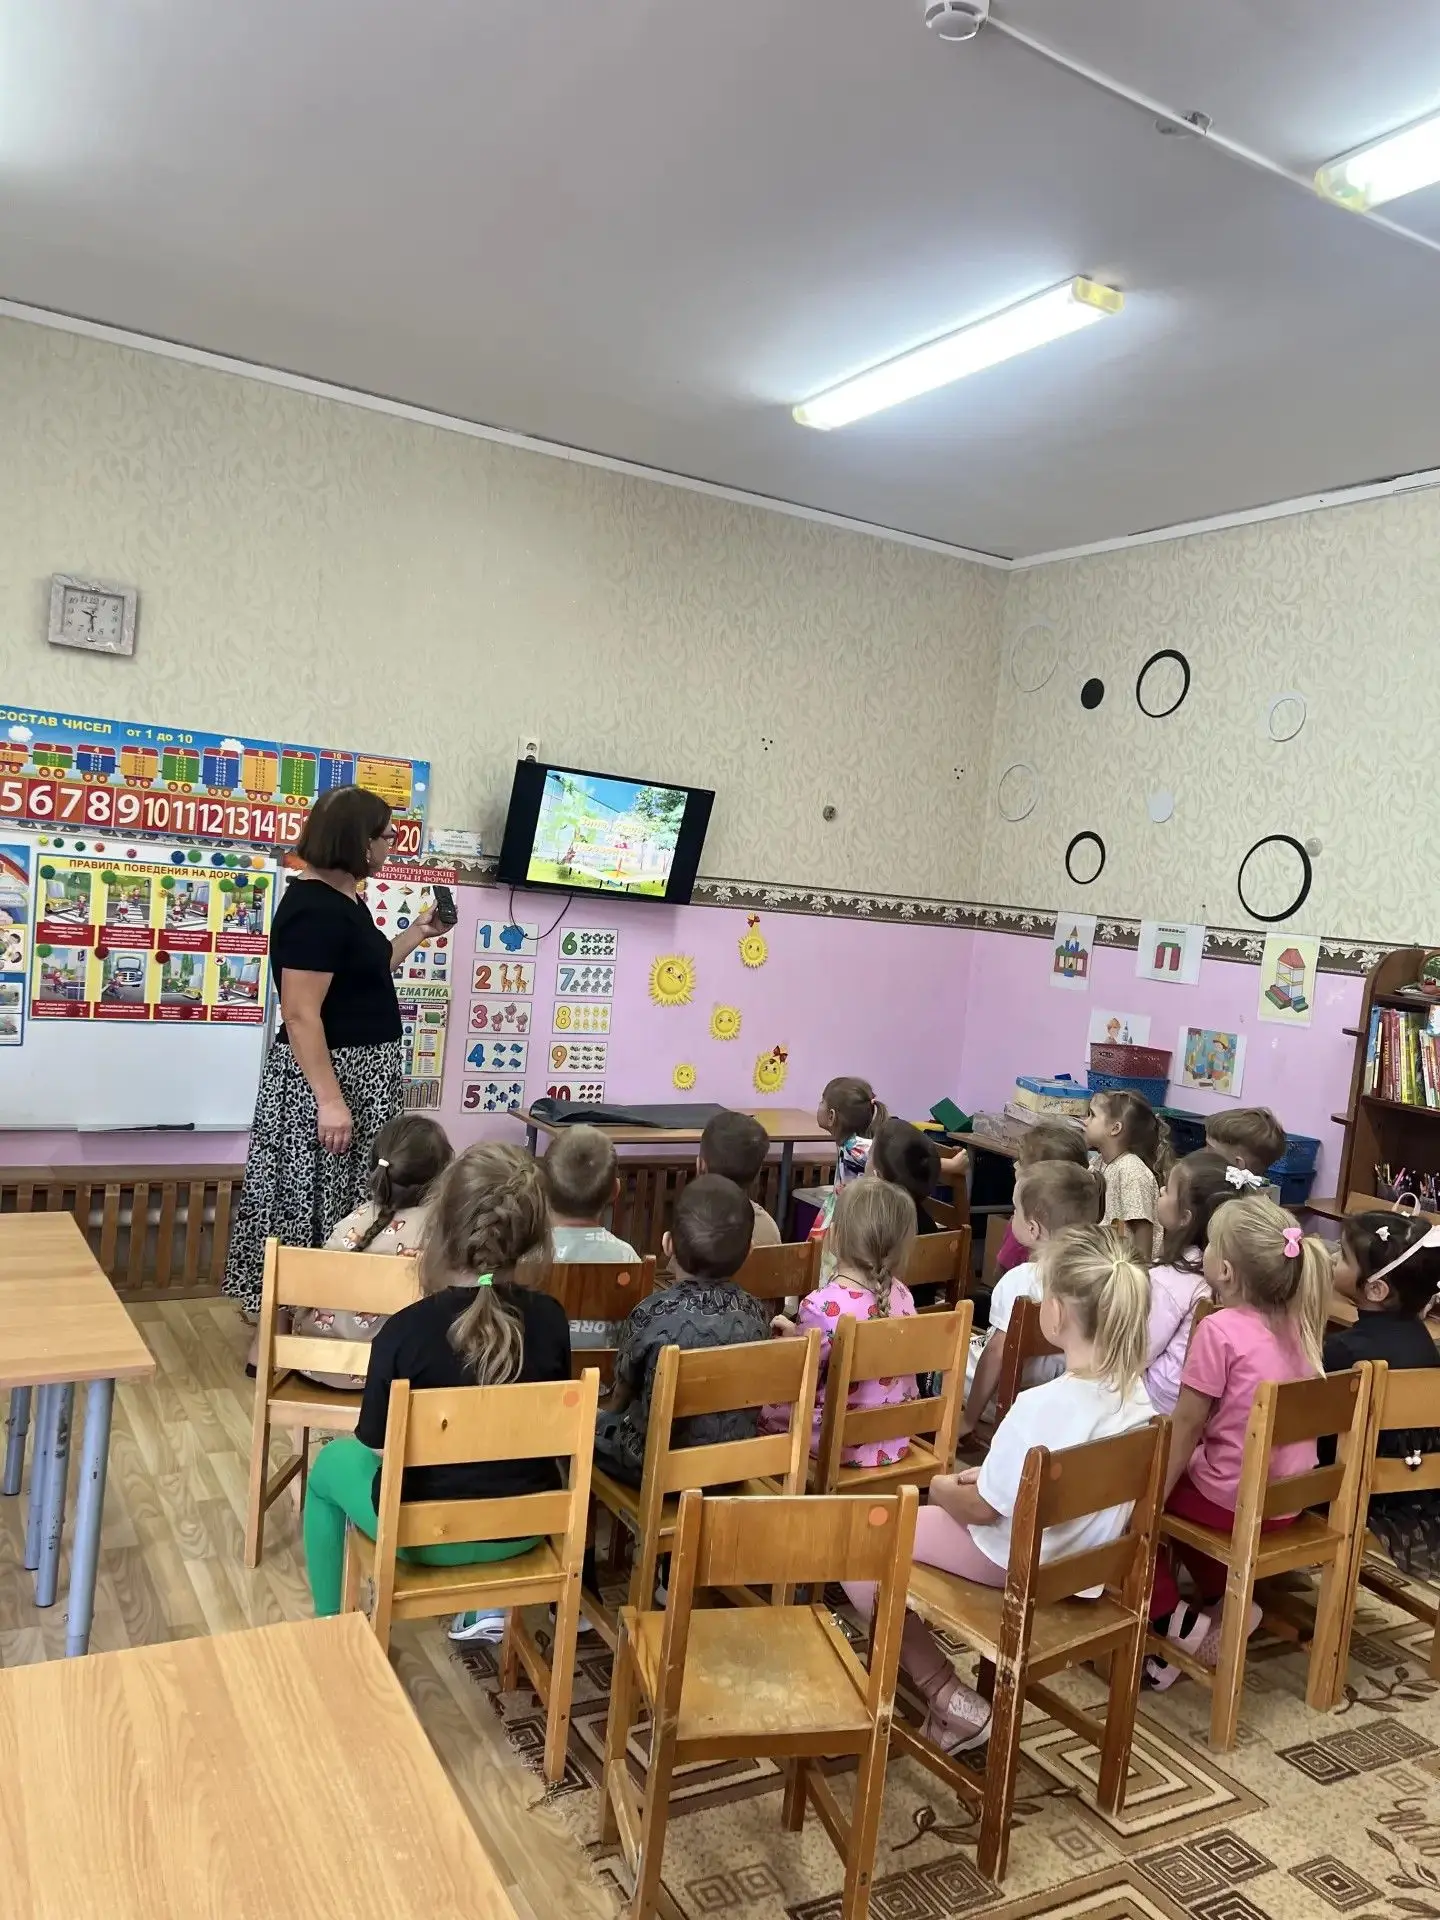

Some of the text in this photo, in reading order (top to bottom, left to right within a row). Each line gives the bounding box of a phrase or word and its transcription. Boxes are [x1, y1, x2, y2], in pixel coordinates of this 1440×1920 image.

[0, 710, 193, 744] СОСТАВ ЧИСЕЛ от 1 до 10
[0, 782, 23, 812] 5
[29, 785, 53, 816] 6
[60, 788, 83, 818] 7
[87, 791, 111, 821] 8
[117, 794, 140, 824] 9
[144, 798, 170, 828] 10
[172, 800, 197, 831] 11
[199, 804, 224, 834] 12
[226, 807, 249, 836] 13
[251, 809, 275, 839] 14
[278, 812, 300, 841] 15
[398, 825, 421, 853] 20
[69, 859, 121, 872] ПРАВИЛА
[124, 863, 189, 877] ПОВЕДЕНИЯ
[192, 868, 206, 878] НА
[376, 872, 411, 881] ФИГУРЫ
[423, 876, 455, 884] ФОРМЫ
[382, 865, 455, 878] ЕОМЕТРИЧЕСКИЕ
[479, 924, 491, 948] 1
[562, 931, 578, 955] 6
[474, 965, 491, 989] 2
[559, 967, 576, 991] 7
[395, 986, 449, 998] ТЕМАТИКА
[471, 1004, 488, 1028] 3
[555, 1006, 571, 1030] 8
[467, 1043, 485, 1067] 4
[551, 1045, 567, 1069] 9
[463, 1084, 481, 1108] 5
[547, 1085, 571, 1101] 10
